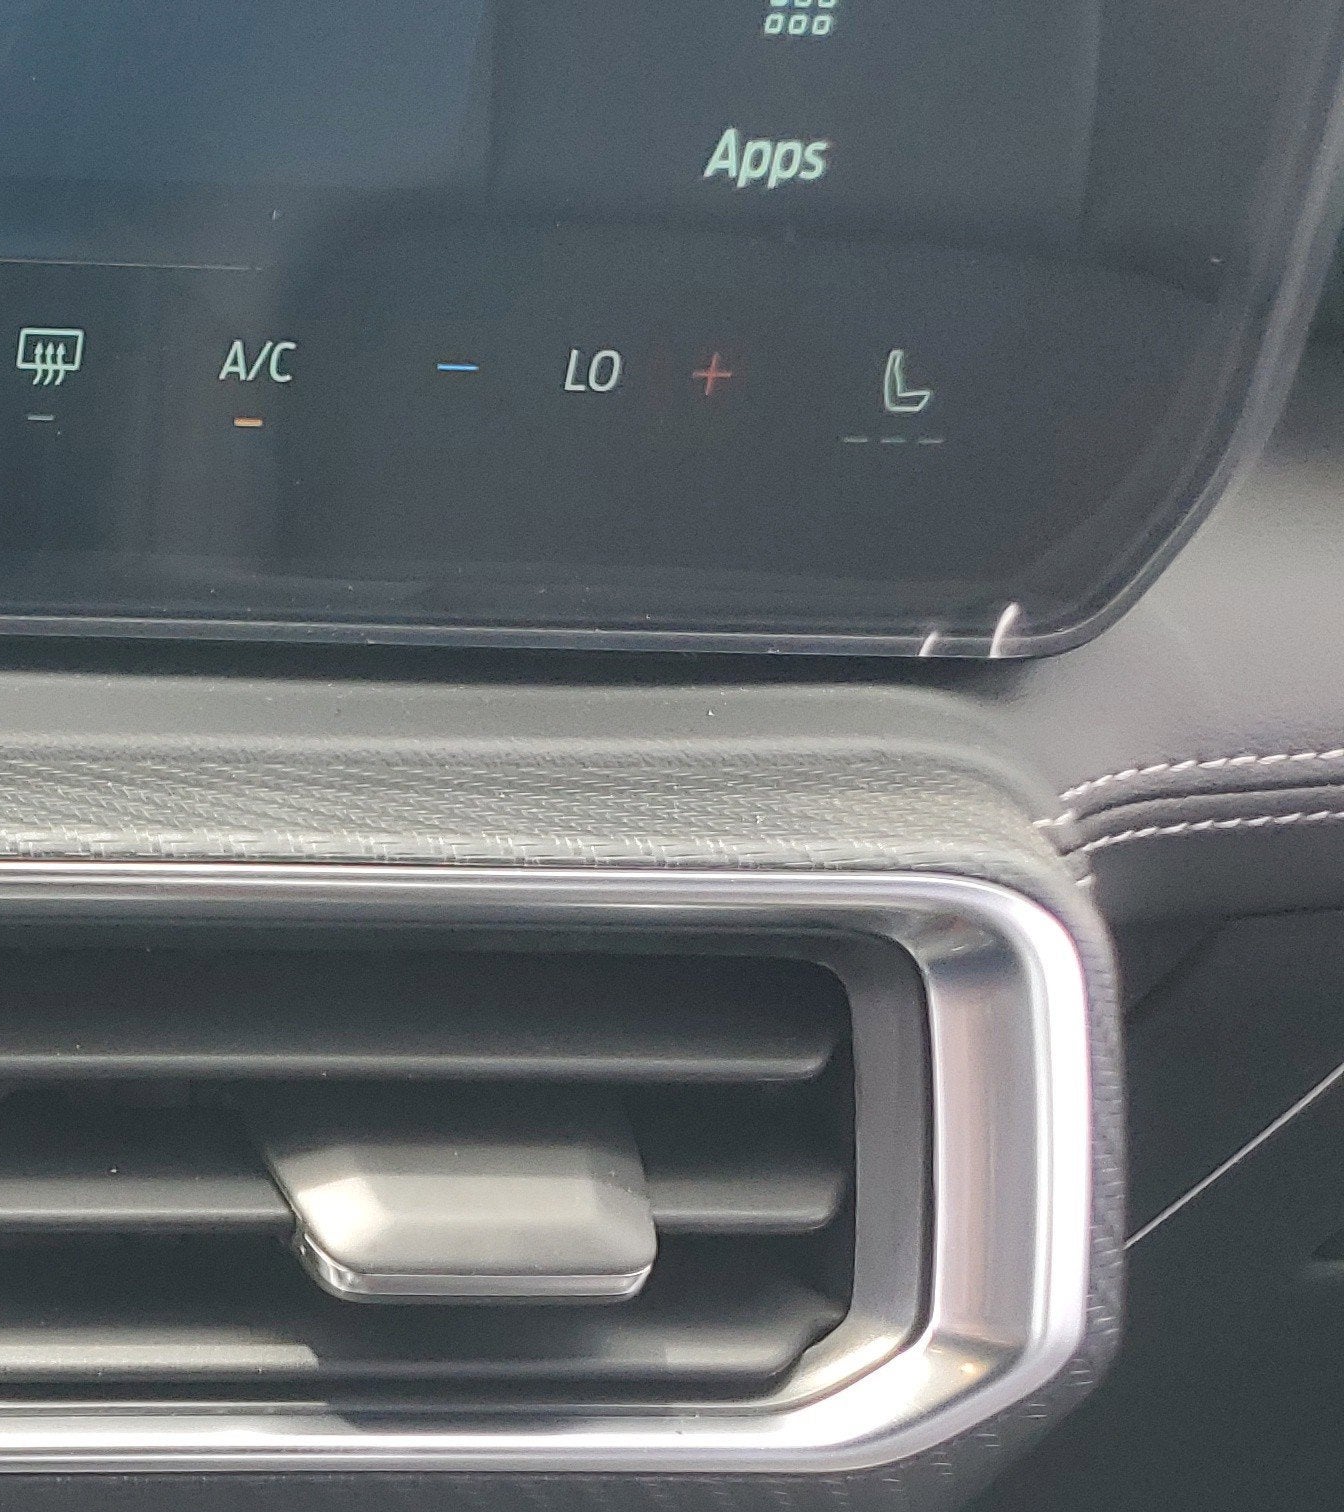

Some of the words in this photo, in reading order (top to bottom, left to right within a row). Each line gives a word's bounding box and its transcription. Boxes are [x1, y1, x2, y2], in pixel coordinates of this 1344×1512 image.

[706, 128, 828, 189] Apps
[220, 340, 296, 383] A/C
[564, 350, 621, 392] LO
